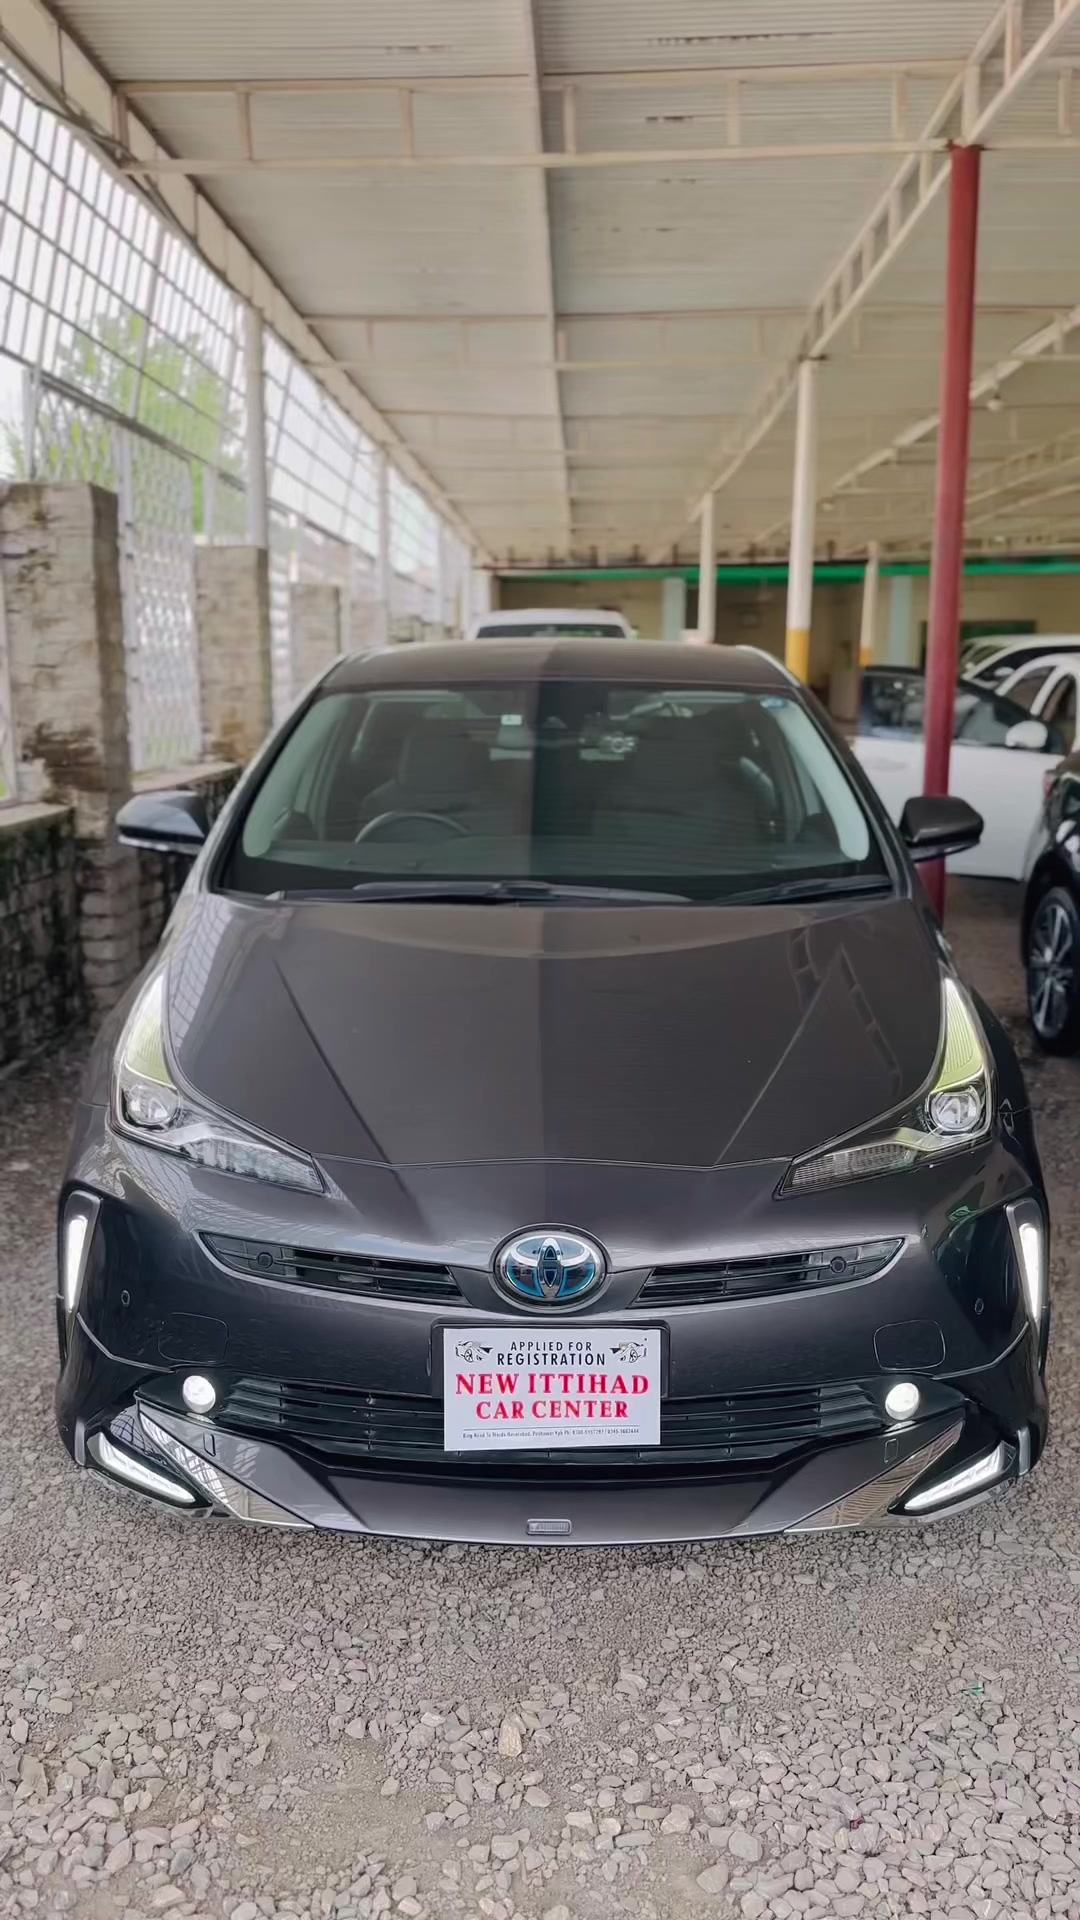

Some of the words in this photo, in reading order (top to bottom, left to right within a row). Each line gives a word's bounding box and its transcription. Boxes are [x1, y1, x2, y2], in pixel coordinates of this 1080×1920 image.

[511, 1341, 563, 1351] APPLIED
[568, 1341, 592, 1351] FOR
[497, 1353, 606, 1366] REGISTRATION
[455, 1374, 520, 1395] NEW
[528, 1373, 649, 1395] ITTIHAD
[476, 1401, 525, 1420] CAR
[532, 1400, 629, 1419] CENTER
